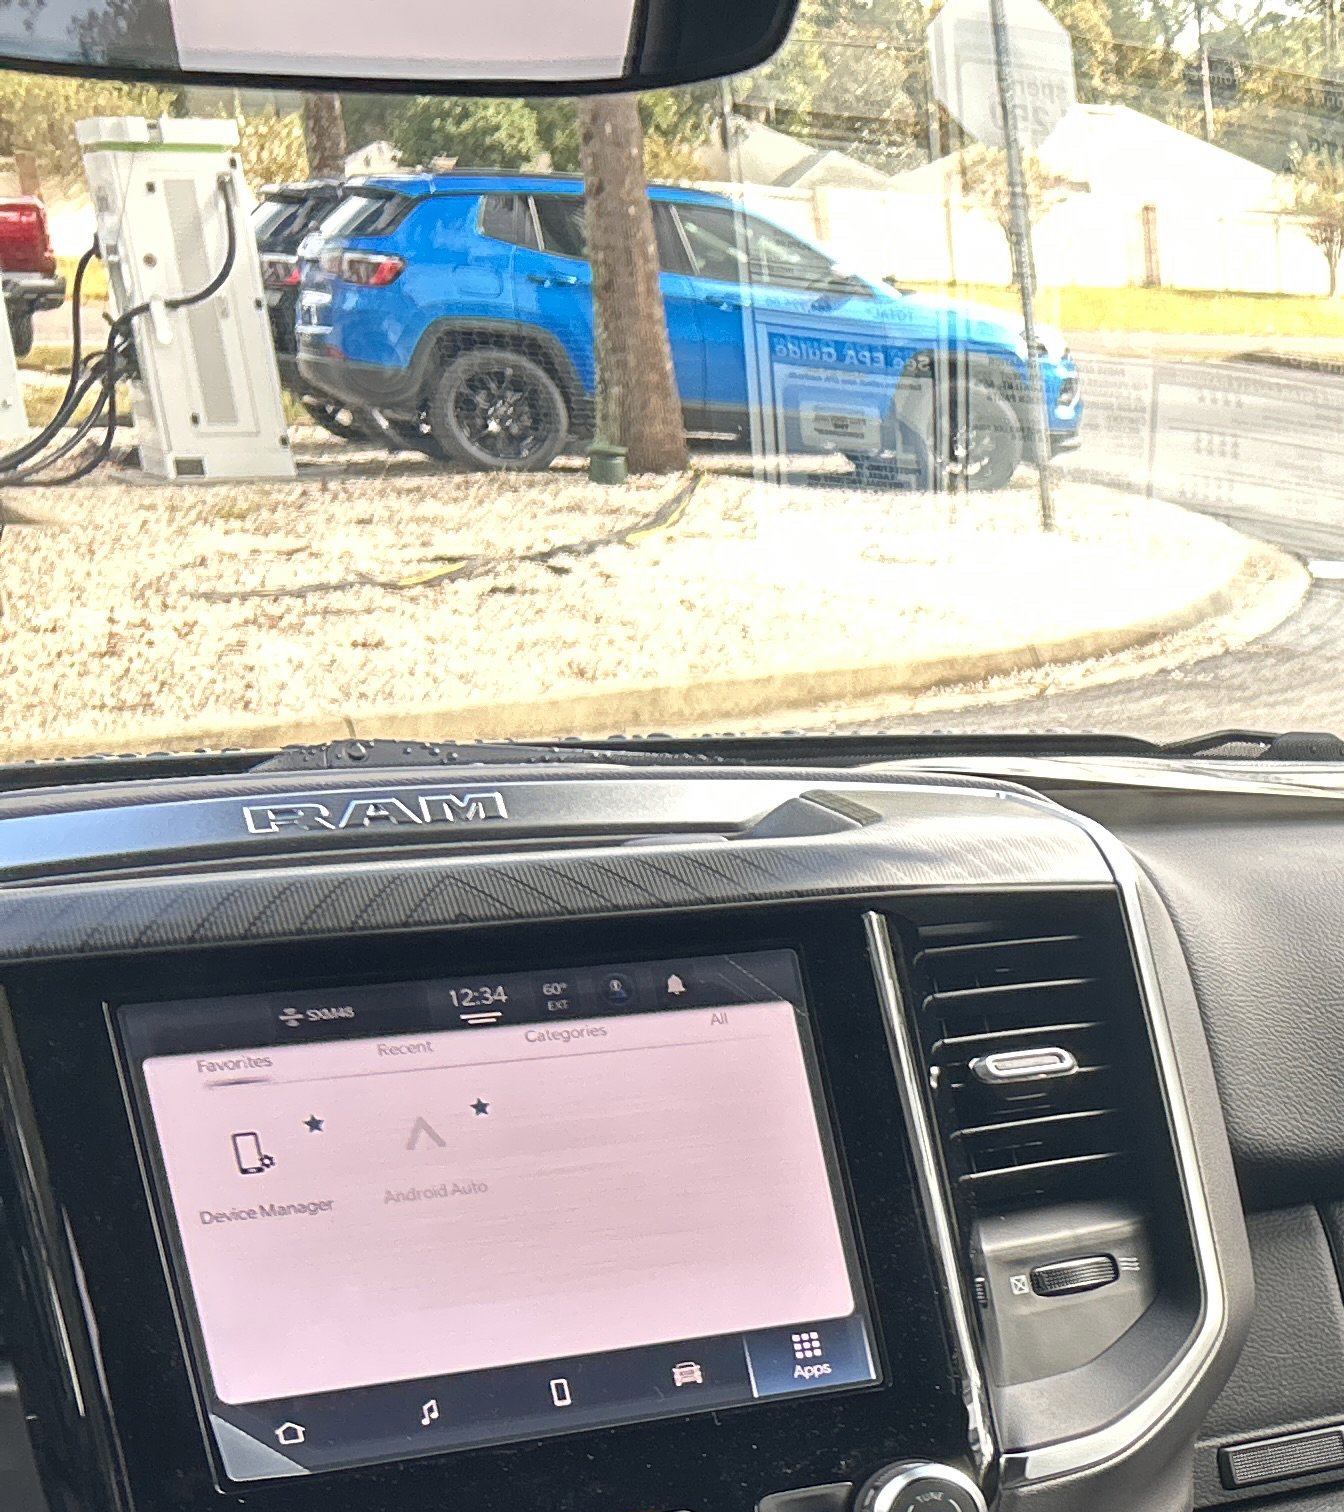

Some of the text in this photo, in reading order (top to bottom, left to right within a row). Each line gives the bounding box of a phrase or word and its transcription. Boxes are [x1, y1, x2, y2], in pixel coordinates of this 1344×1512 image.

[242, 791, 510, 834] RAM
[449, 985, 508, 1008] 12:34
[710, 1011, 729, 1026] All
[524, 1024, 608, 1044] Categories
[377, 1040, 433, 1058] Recent
[197, 1053, 272, 1075] Favorites
[384, 1181, 488, 1204] Android Auto
[199, 1200, 335, 1226] Device Manager
[794, 1360, 832, 1380] Apps
[915, 1491, 944, 1504] TUNE
